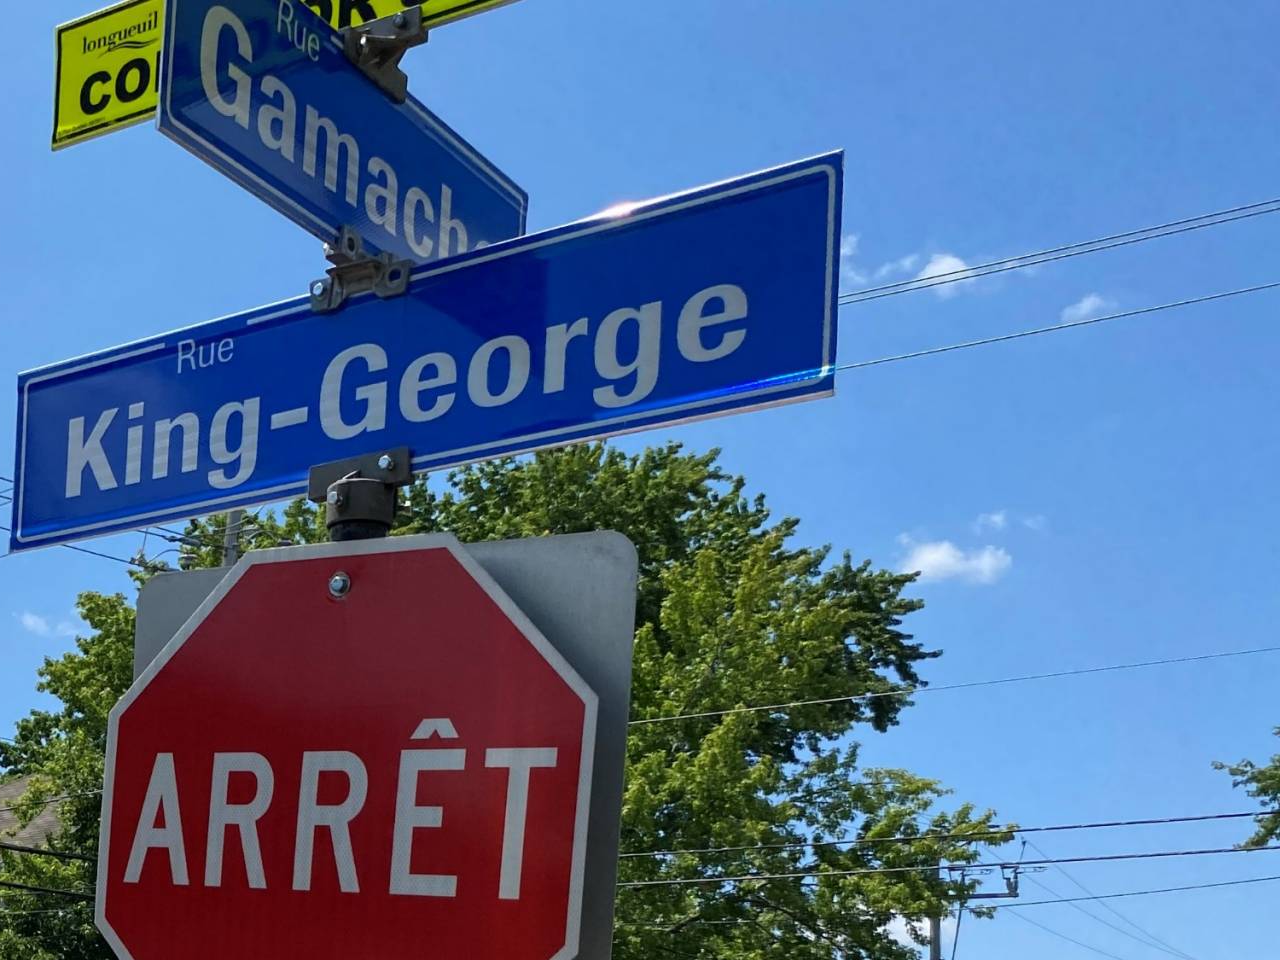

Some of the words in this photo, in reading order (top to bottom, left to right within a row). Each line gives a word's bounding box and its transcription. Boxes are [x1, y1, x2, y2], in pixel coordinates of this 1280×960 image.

[82, 10, 158, 54] longueuil
[276, 0, 320, 61] Rue
[80, 50, 160, 115] CO
[199, 4, 489, 260] Gamach
[176, 338, 235, 375] Rue
[64, 283, 748, 500] King-George
[123, 717, 558, 900] ARRÊT
